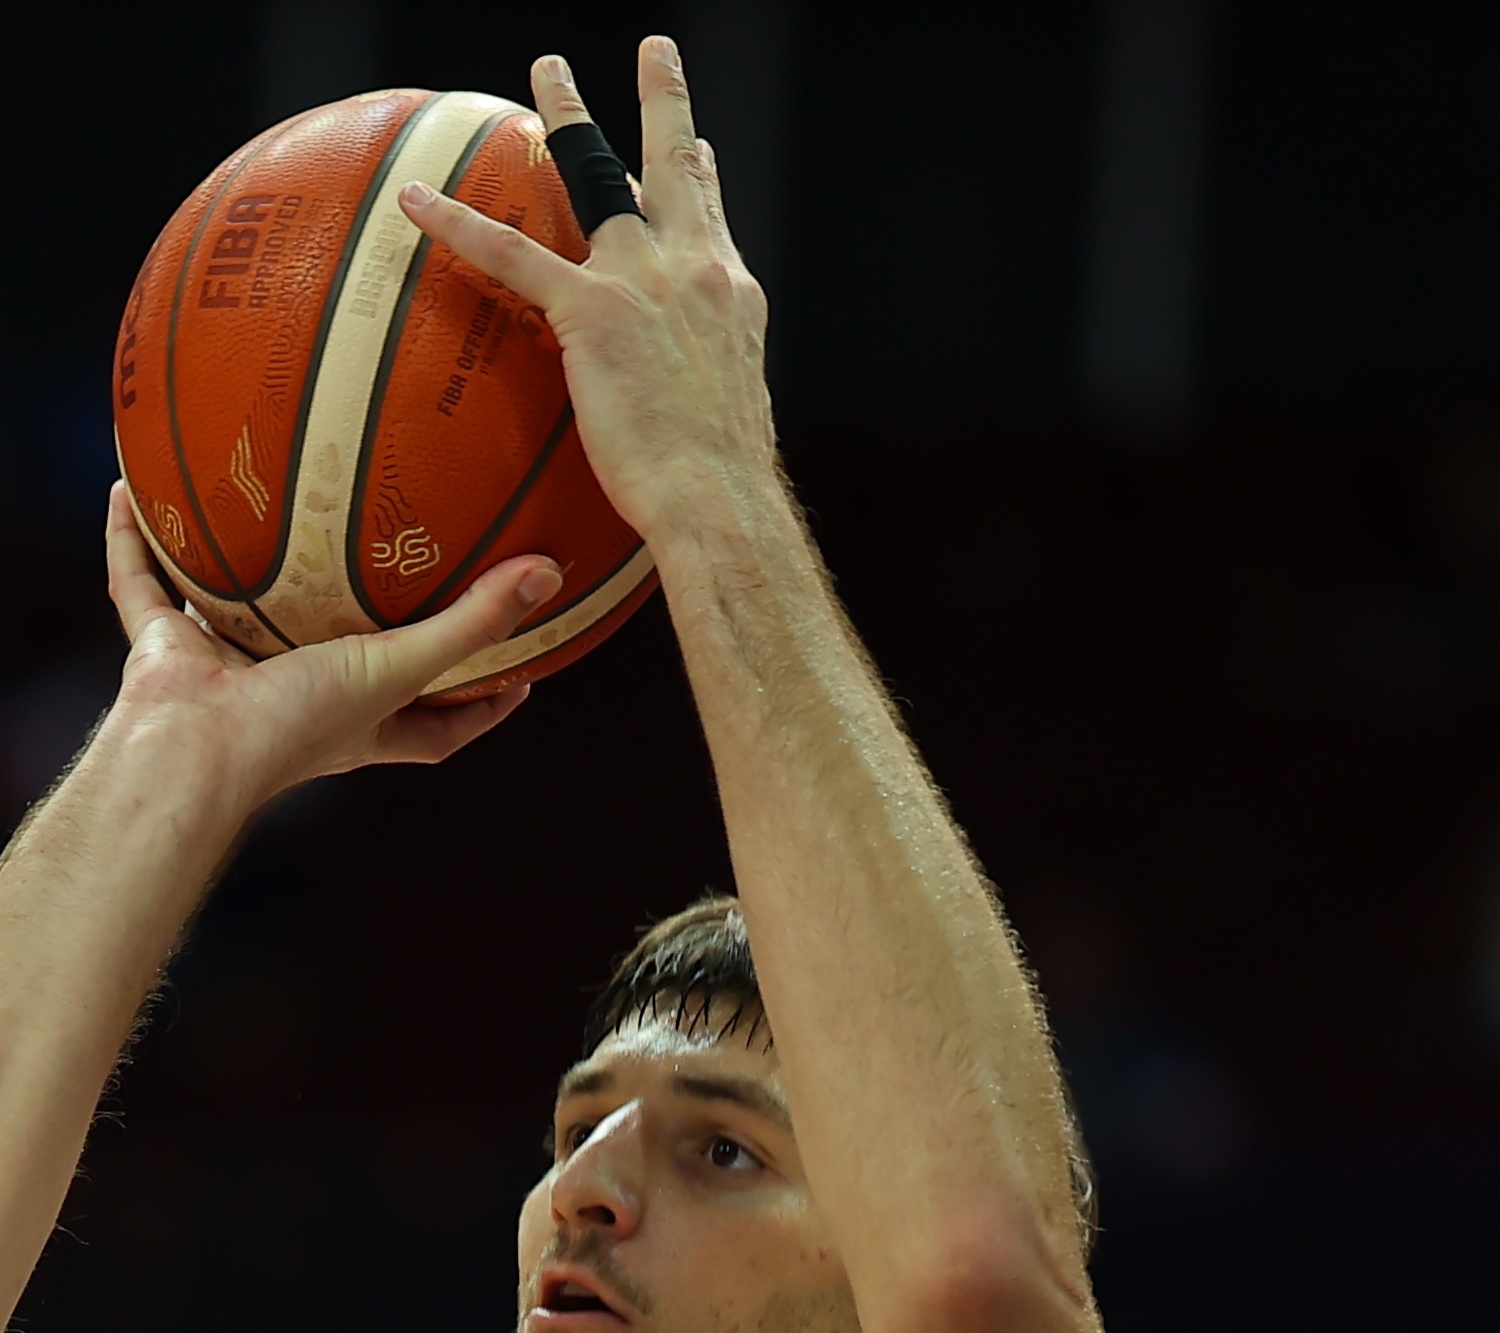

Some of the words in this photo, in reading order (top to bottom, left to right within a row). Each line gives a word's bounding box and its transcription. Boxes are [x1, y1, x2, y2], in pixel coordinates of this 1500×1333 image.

[198, 194, 276, 308] FIBA
[249, 196, 302, 309] APPROVED
[436, 373, 469, 417] FIBA
